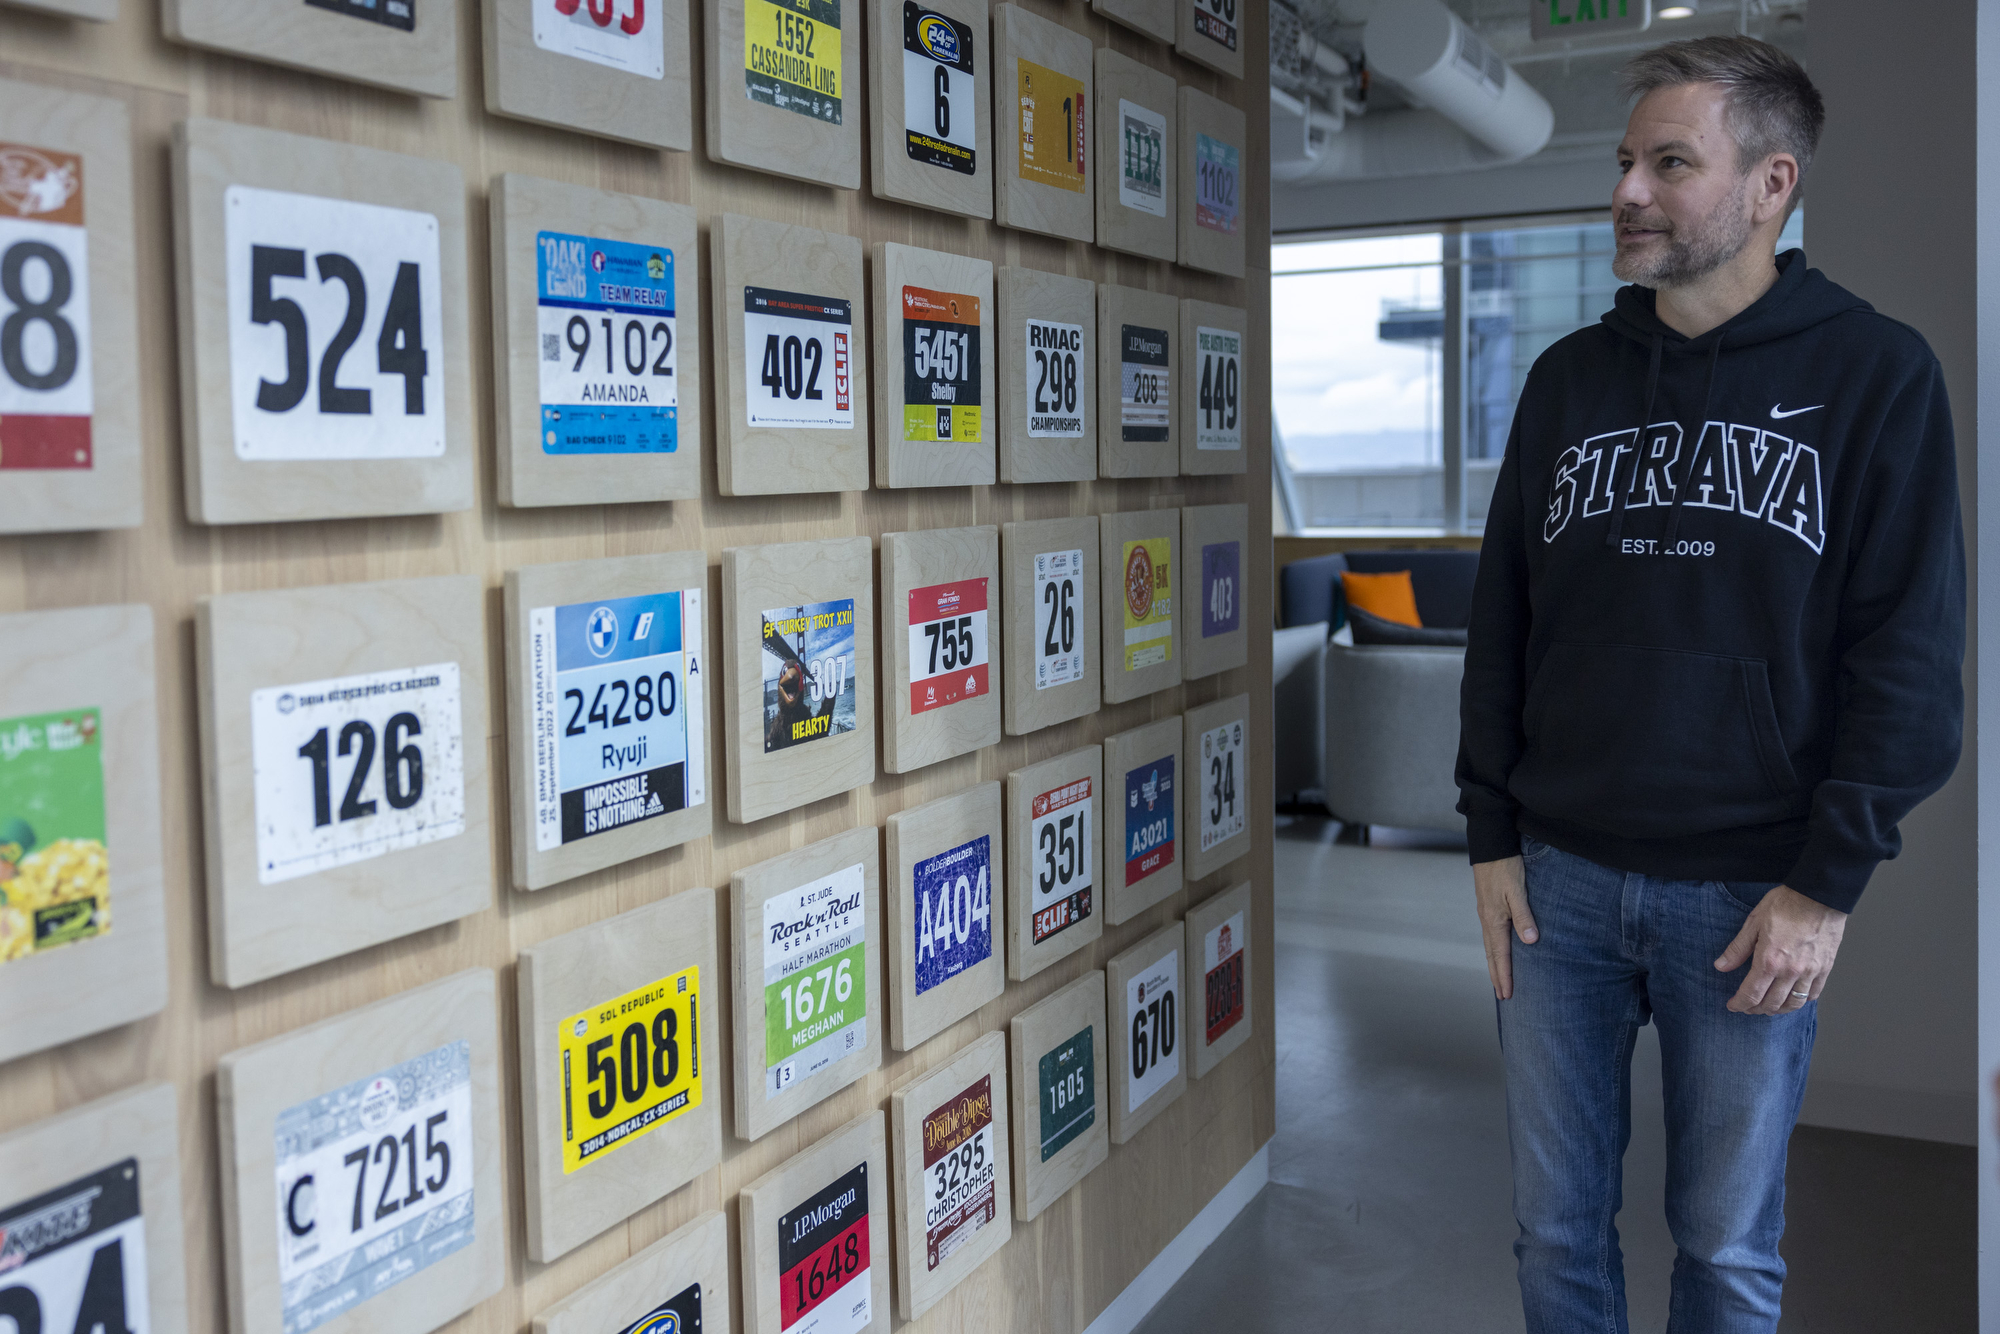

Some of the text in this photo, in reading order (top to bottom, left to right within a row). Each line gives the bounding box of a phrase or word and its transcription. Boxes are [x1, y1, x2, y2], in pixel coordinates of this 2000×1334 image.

[775, 9, 814, 59] 1552
[928, 24, 946, 47] 24
[932, 45, 959, 61] ADRENALIN
[944, 41, 952, 49] OF
[945, 34, 955, 44] HRS
[751, 42, 836, 96] CASSANDRA LING
[934, 64, 950, 138] 6
[1062, 97, 1072, 163] 1
[1125, 128, 1161, 187] 1132
[1201, 161, 1235, 207] 1102
[0, 240, 79, 391] 8
[600, 284, 667, 307] TEAM RELAY
[755, 298, 768, 306] 2016
[778, 300, 790, 309] AREA
[790, 302, 804, 311] SUPER
[830, 308, 844, 316] SERIES
[951, 302, 959, 315] 2
[250, 243, 428, 416] 524
[566, 315, 673, 377] 9102
[1030, 324, 1080, 352] RMAC
[1128, 336, 1162, 359] J.P.Morgan
[761, 334, 823, 400] 402
[836, 336, 848, 394] CLIF
[914, 327, 968, 381] 5451
[581, 383, 650, 403] AMANDA
[837, 395, 849, 404] BAR
[931, 382, 957, 403] Shelby
[1034, 349, 1077, 413] 298
[1134, 372, 1159, 404] 208
[1200, 354, 1238, 430] 449
[566, 436, 581, 445] BAG
[583, 436, 606, 445] CHECK
[607, 434, 627, 445] 9102
[1030, 416, 1081, 432] CHAMPIONSHIPS
[1544, 421, 1826, 556] STRAVA
[1621, 539, 1716, 556] EST. 009
[1155, 563, 1168, 589] 5K
[1044, 579, 1074, 657] 26
[1151, 598, 1172, 617] 1182
[1210, 576, 1233, 622] 403
[763, 609, 853, 639] SF TURKEY TROT XXII
[924, 615, 973, 674] 755
[690, 657, 699, 676] A
[810, 654, 847, 702] 307
[534, 633, 547, 767] BERLIN-MARATHON
[564, 670, 676, 738] 24280
[547, 709, 555, 736] 2022
[792, 714, 830, 741] HEARTY
[297, 711, 424, 828] 126
[548, 738, 557, 801] September
[601, 735, 648, 771] Ryuji
[538, 772, 548, 802] BMW
[584, 774, 649, 812] IMPOSSIBLE
[1210, 751, 1235, 826] 34
[584, 796, 646, 834] IS NOTHING
[645, 804, 664, 816] adidas
[1039, 810, 1084, 894] 351
[1131, 817, 1167, 856] A3021
[924, 847, 973, 876] BOLDERBOULDER
[1141, 853, 1160, 872] GRACE
[807, 886, 833, 905] ST. JUDE
[918, 864, 990, 965] A404
[770, 912, 815, 944] Rock
[827, 892, 861, 920] Roll
[784, 915, 849, 951] SEATTLE
[1042, 901, 1068, 934] CLIF
[782, 935, 851, 975] HALF MARATHON
[600, 988, 665, 1024] SOL REPUBLIC
[780, 957, 853, 1030] 1676
[792, 1009, 844, 1048] MEGHANN
[1132, 990, 1175, 1079] 670
[586, 1007, 679, 1120] 508
[784, 1067, 790, 1081] 3
[656, 1092, 686, 1117] SERIES
[1050, 1066, 1084, 1115] 1605
[924, 1108, 960, 1151] Double
[344, 1110, 451, 1234] 7215
[934, 1132, 985, 1200] 3295
[287, 1174, 316, 1237] C
[926, 1162, 994, 1227] CHRISTOPHER
[792, 1187, 856, 1244] J.P.Morgan
[795, 1232, 860, 1313] 1648
